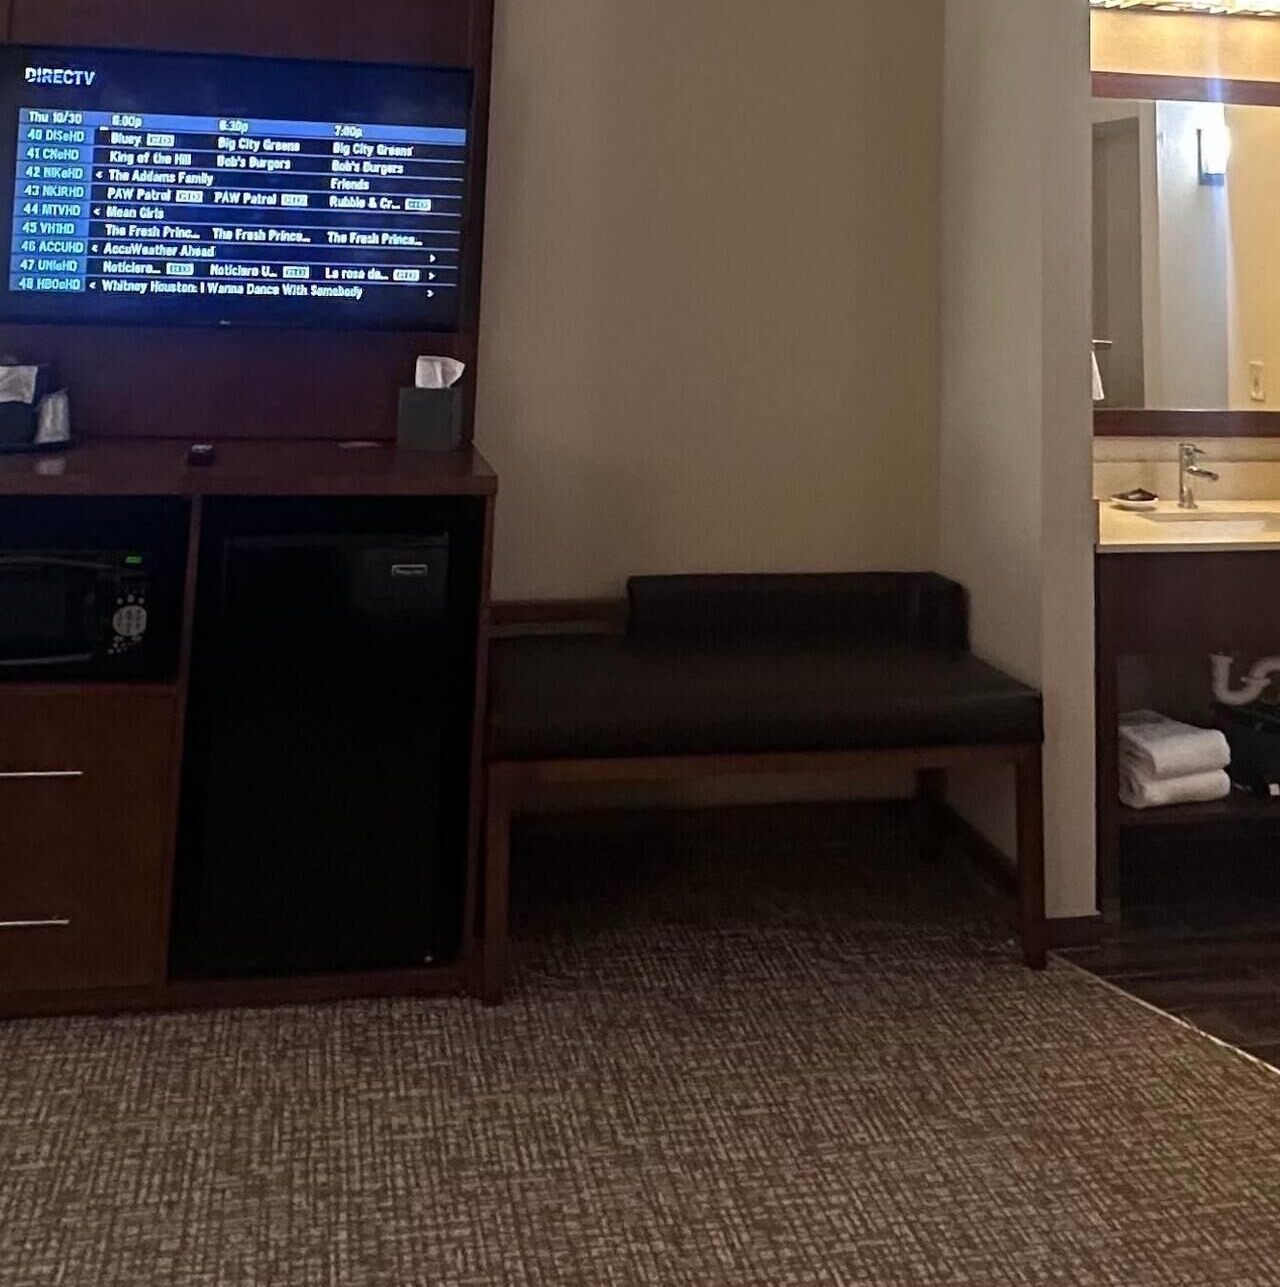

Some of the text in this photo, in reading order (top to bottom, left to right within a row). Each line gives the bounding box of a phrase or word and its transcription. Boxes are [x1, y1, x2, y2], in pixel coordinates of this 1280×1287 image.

[25, 67, 96, 85] DIRECTV
[29, 111, 83, 125] Thu 10/30
[27, 128, 43, 140] 40
[217, 136, 236, 151] Big
[238, 137, 260, 152] City
[332, 141, 350, 156] Big
[352, 143, 375, 157] City
[109, 150, 192, 166] King of the Hill
[216, 154, 291, 171] Bob's Burgers
[25, 165, 41, 178] 42
[331, 159, 404, 176] Bob's Burgers
[108, 168, 130, 182] The
[178, 171, 214, 187] Family
[330, 177, 370, 191] Friends
[24, 184, 40, 196] 43
[107, 186, 135, 200] PAW
[136, 188, 172, 202] Patrol
[213, 191, 241, 204] PAW
[242, 192, 277, 205] Patrol
[367, 197, 378, 210] &
[23, 203, 81, 216] 44 MTVHD
[106, 205, 137, 218] Mean
[22, 222, 37, 234] 45
[105, 223, 127, 236] The
[128, 224, 161, 238] Fresh
[212, 227, 233, 241] The
[234, 228, 266, 241] Fresh
[327, 231, 348, 244] The
[349, 231, 380, 245] Fresh
[21, 240, 84, 253] 46 ACCUHD
[103, 242, 217, 257] AccuWeather Ahead
[20, 259, 35, 271] 47
[325, 267, 340, 279] La
[102, 279, 148, 294] Whitney
[207, 281, 245, 294] Wanna
[246, 282, 280, 296] Dance
[281, 283, 308, 296] With
[310, 284, 363, 300] Somebody
